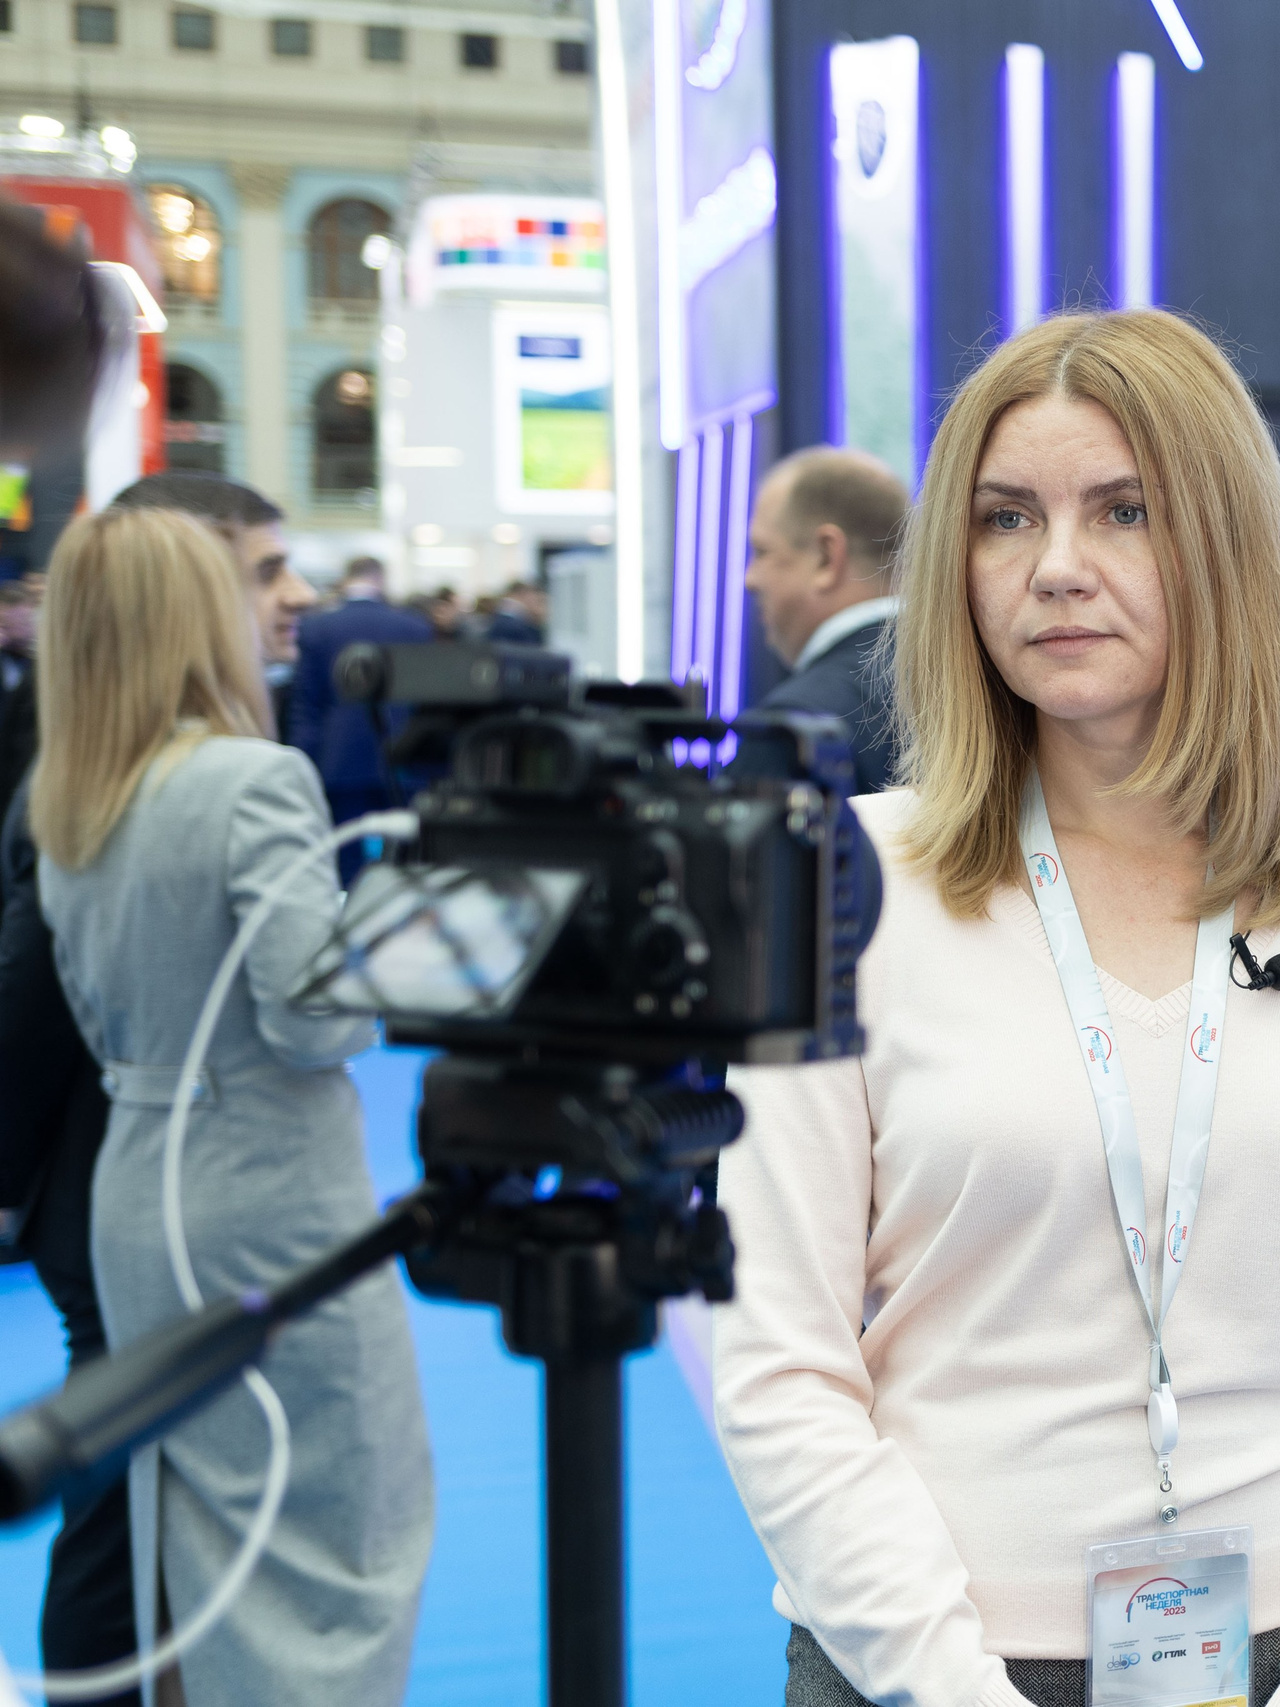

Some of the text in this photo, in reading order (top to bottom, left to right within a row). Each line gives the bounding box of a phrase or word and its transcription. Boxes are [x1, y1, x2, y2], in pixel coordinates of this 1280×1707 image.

[1087, 1048, 1096, 1062] 2023
[1136, 1586, 1209, 1603] ТРАНСПОРТНАЯ
[1145, 1598, 1182, 1610] НЕДЕЛЯ
[1163, 1606, 1186, 1616] 2023
[1164, 1649, 1187, 1659] ГТЛК
